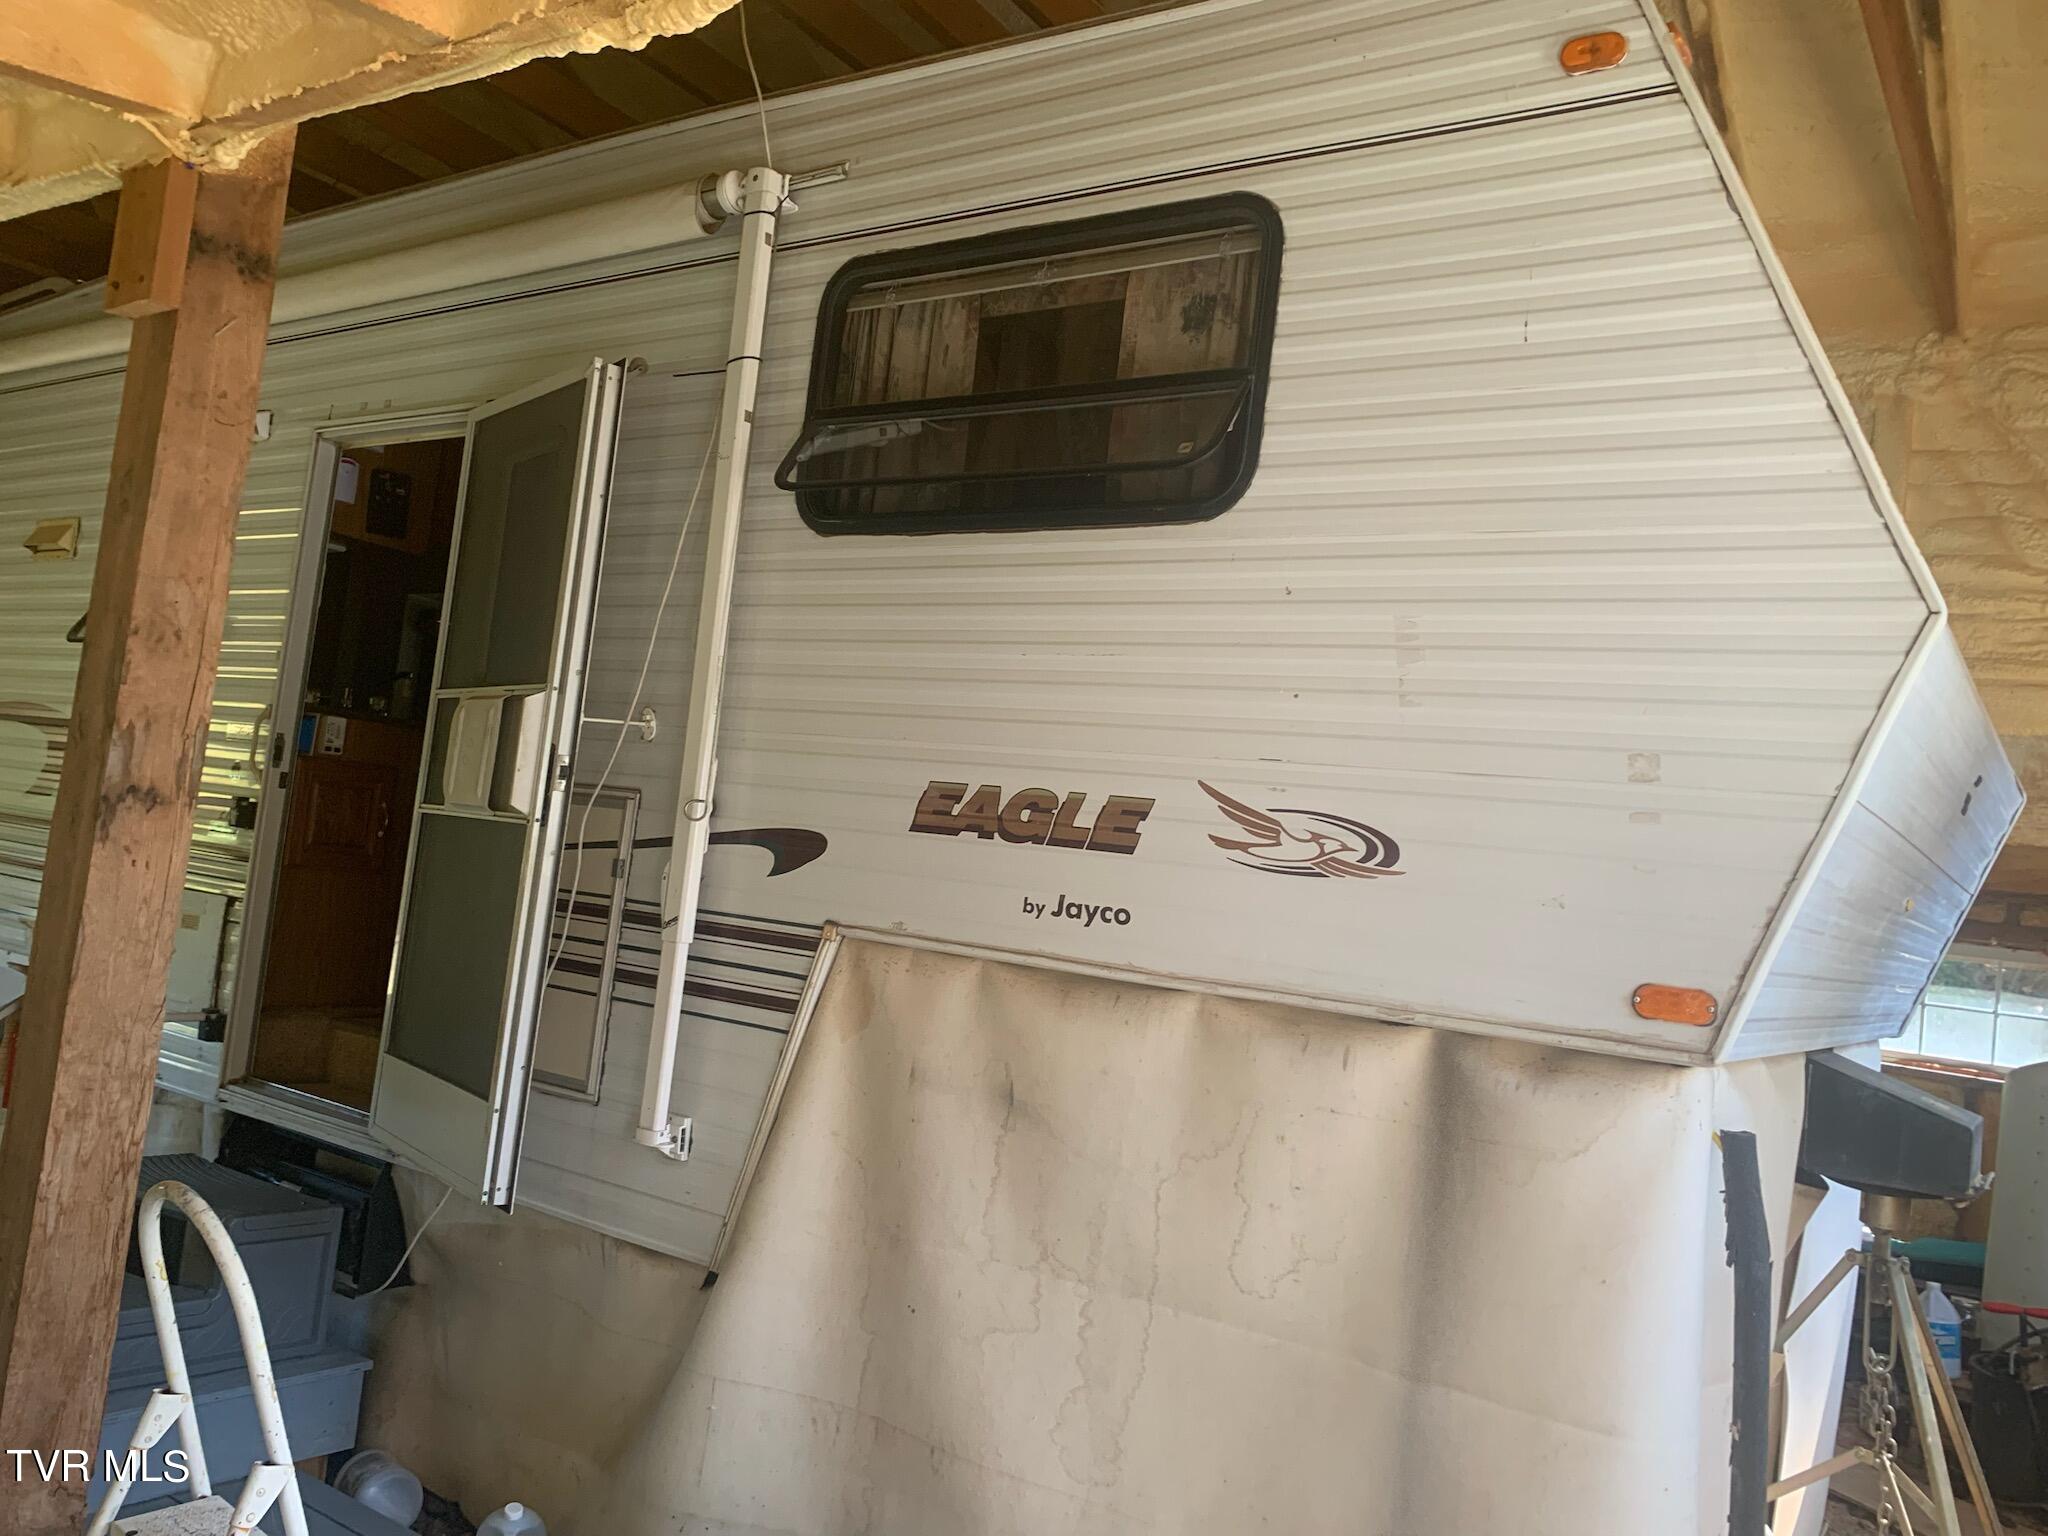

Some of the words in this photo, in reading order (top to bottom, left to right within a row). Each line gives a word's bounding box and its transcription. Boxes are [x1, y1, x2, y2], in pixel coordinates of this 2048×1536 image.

[908, 780, 1156, 855] EAGLE
[1022, 896, 1046, 919] by
[1050, 894, 1131, 927] Jayco
